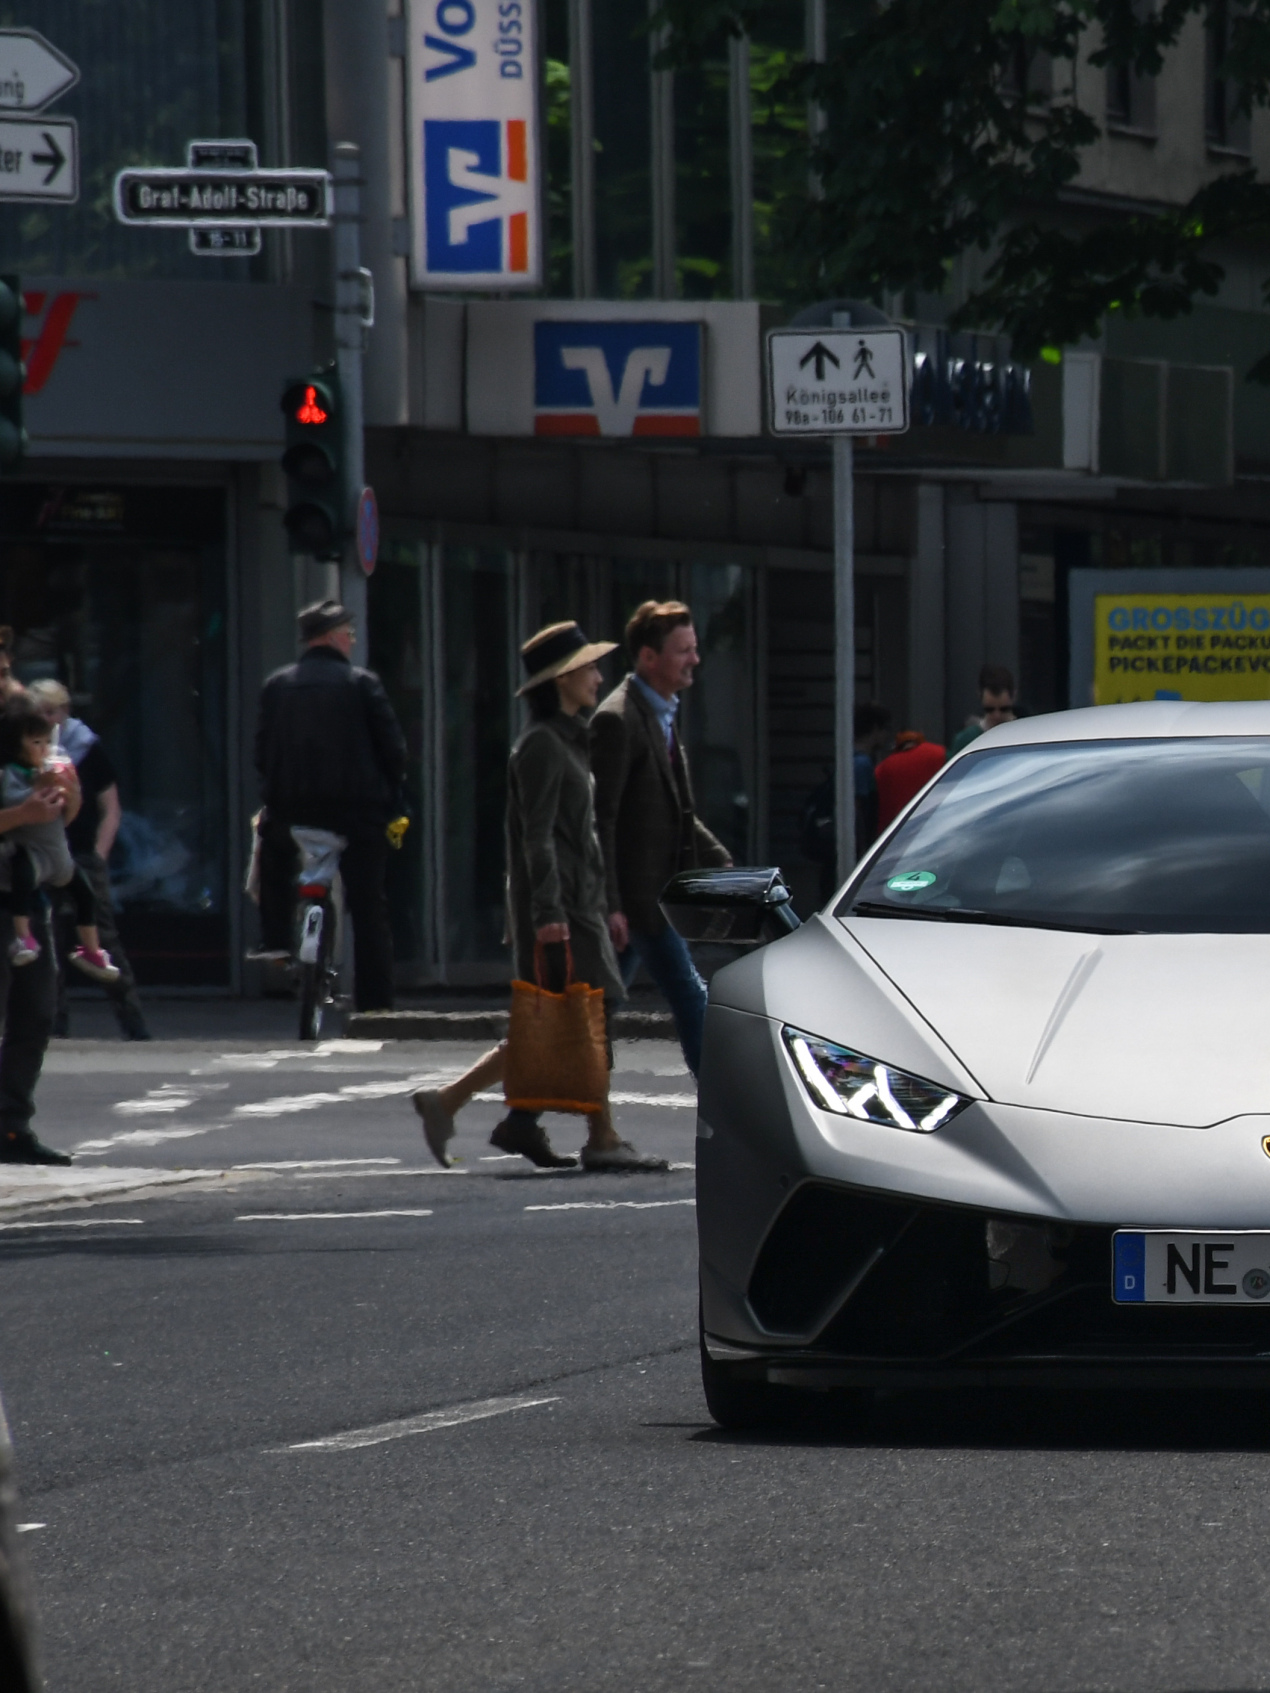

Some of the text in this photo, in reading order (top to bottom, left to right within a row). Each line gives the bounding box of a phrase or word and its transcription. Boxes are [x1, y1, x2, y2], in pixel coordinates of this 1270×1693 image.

[139, 185, 309, 212] Graf-Adolf-Straße
[786, 387, 891, 408] Königsallee
[1108, 635, 1170, 651] PACKT
[1176, 635, 1205, 651] DIE
[1124, 1275, 1136, 1291] D
[1167, 1243, 1237, 1294] NE
